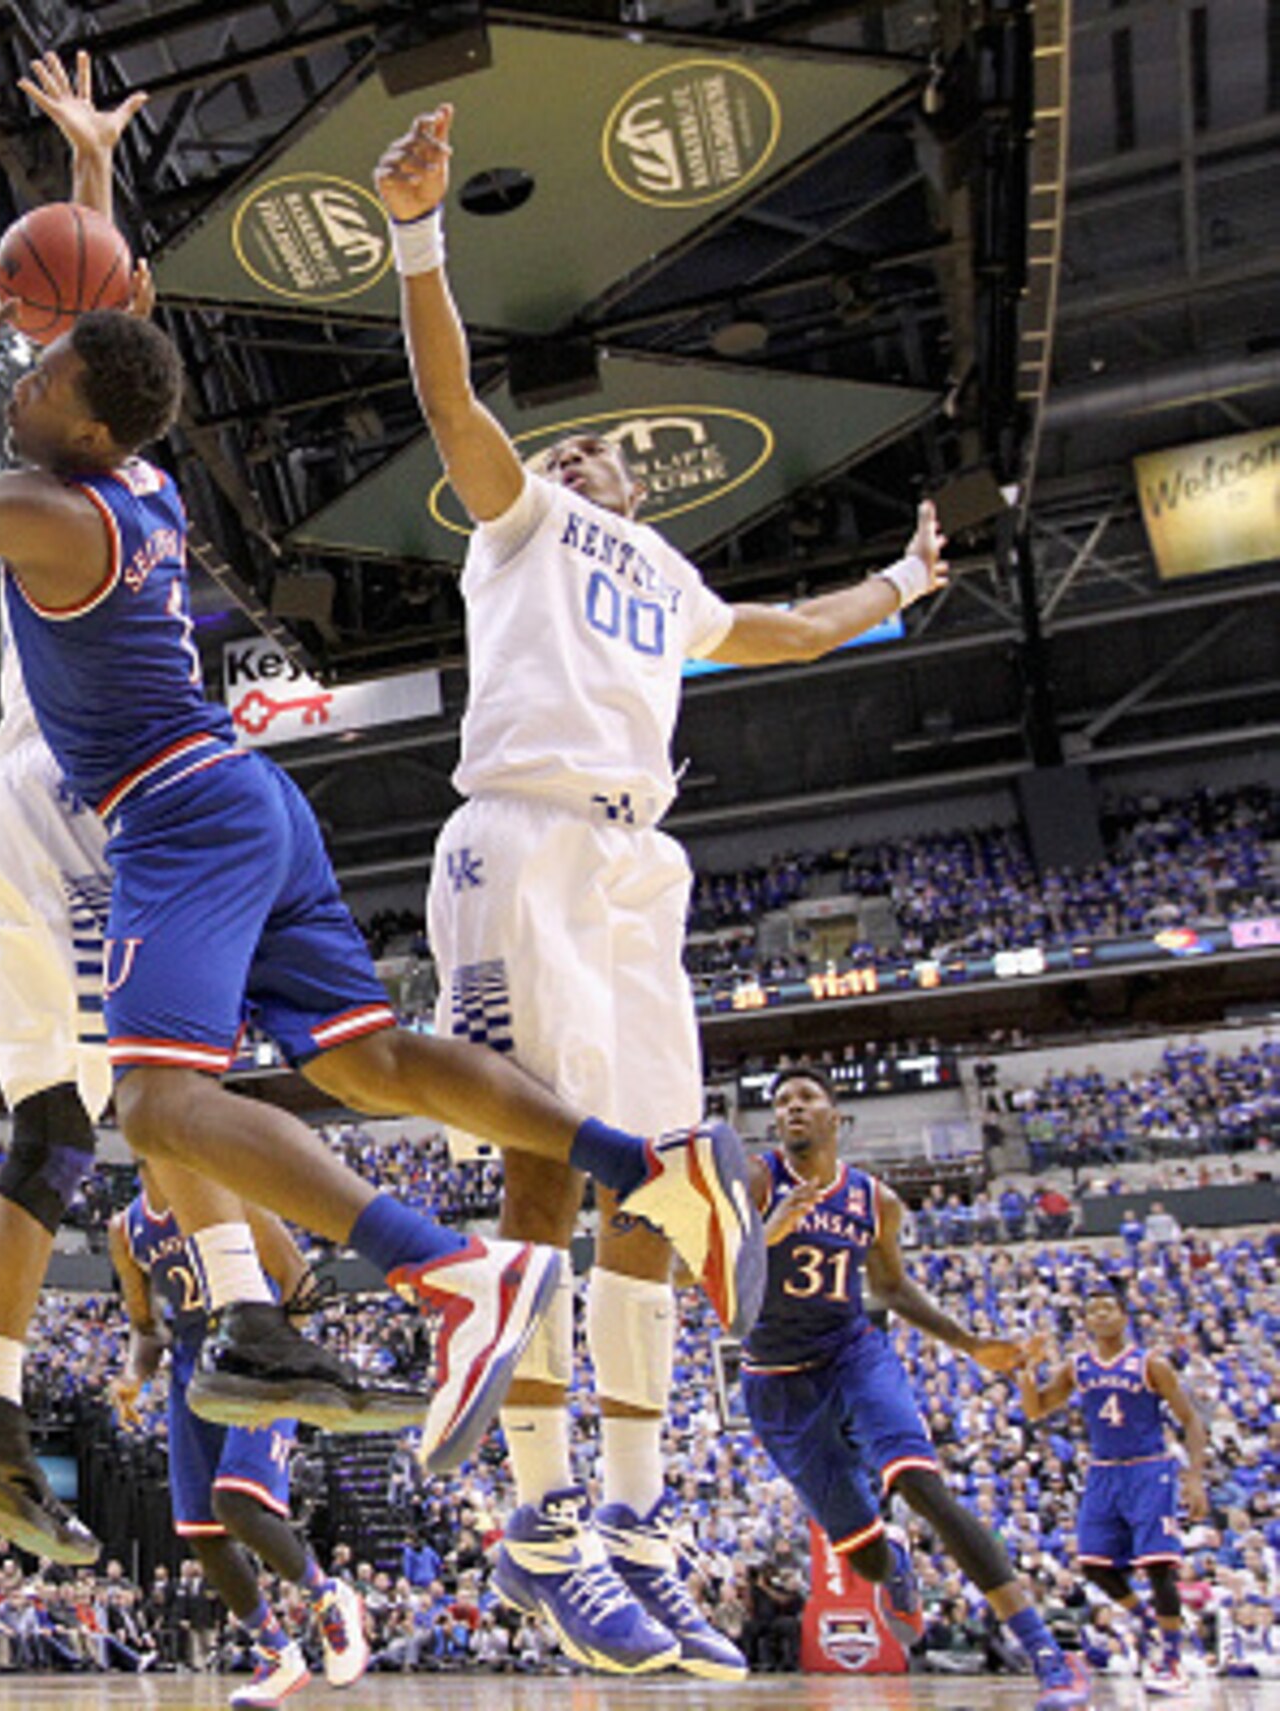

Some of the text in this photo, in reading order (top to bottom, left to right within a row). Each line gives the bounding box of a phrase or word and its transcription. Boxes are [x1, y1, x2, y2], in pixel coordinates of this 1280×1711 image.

[586, 569, 666, 657] 00
[782, 1245, 852, 1302] 31
[1098, 1392, 1126, 1428] 4
